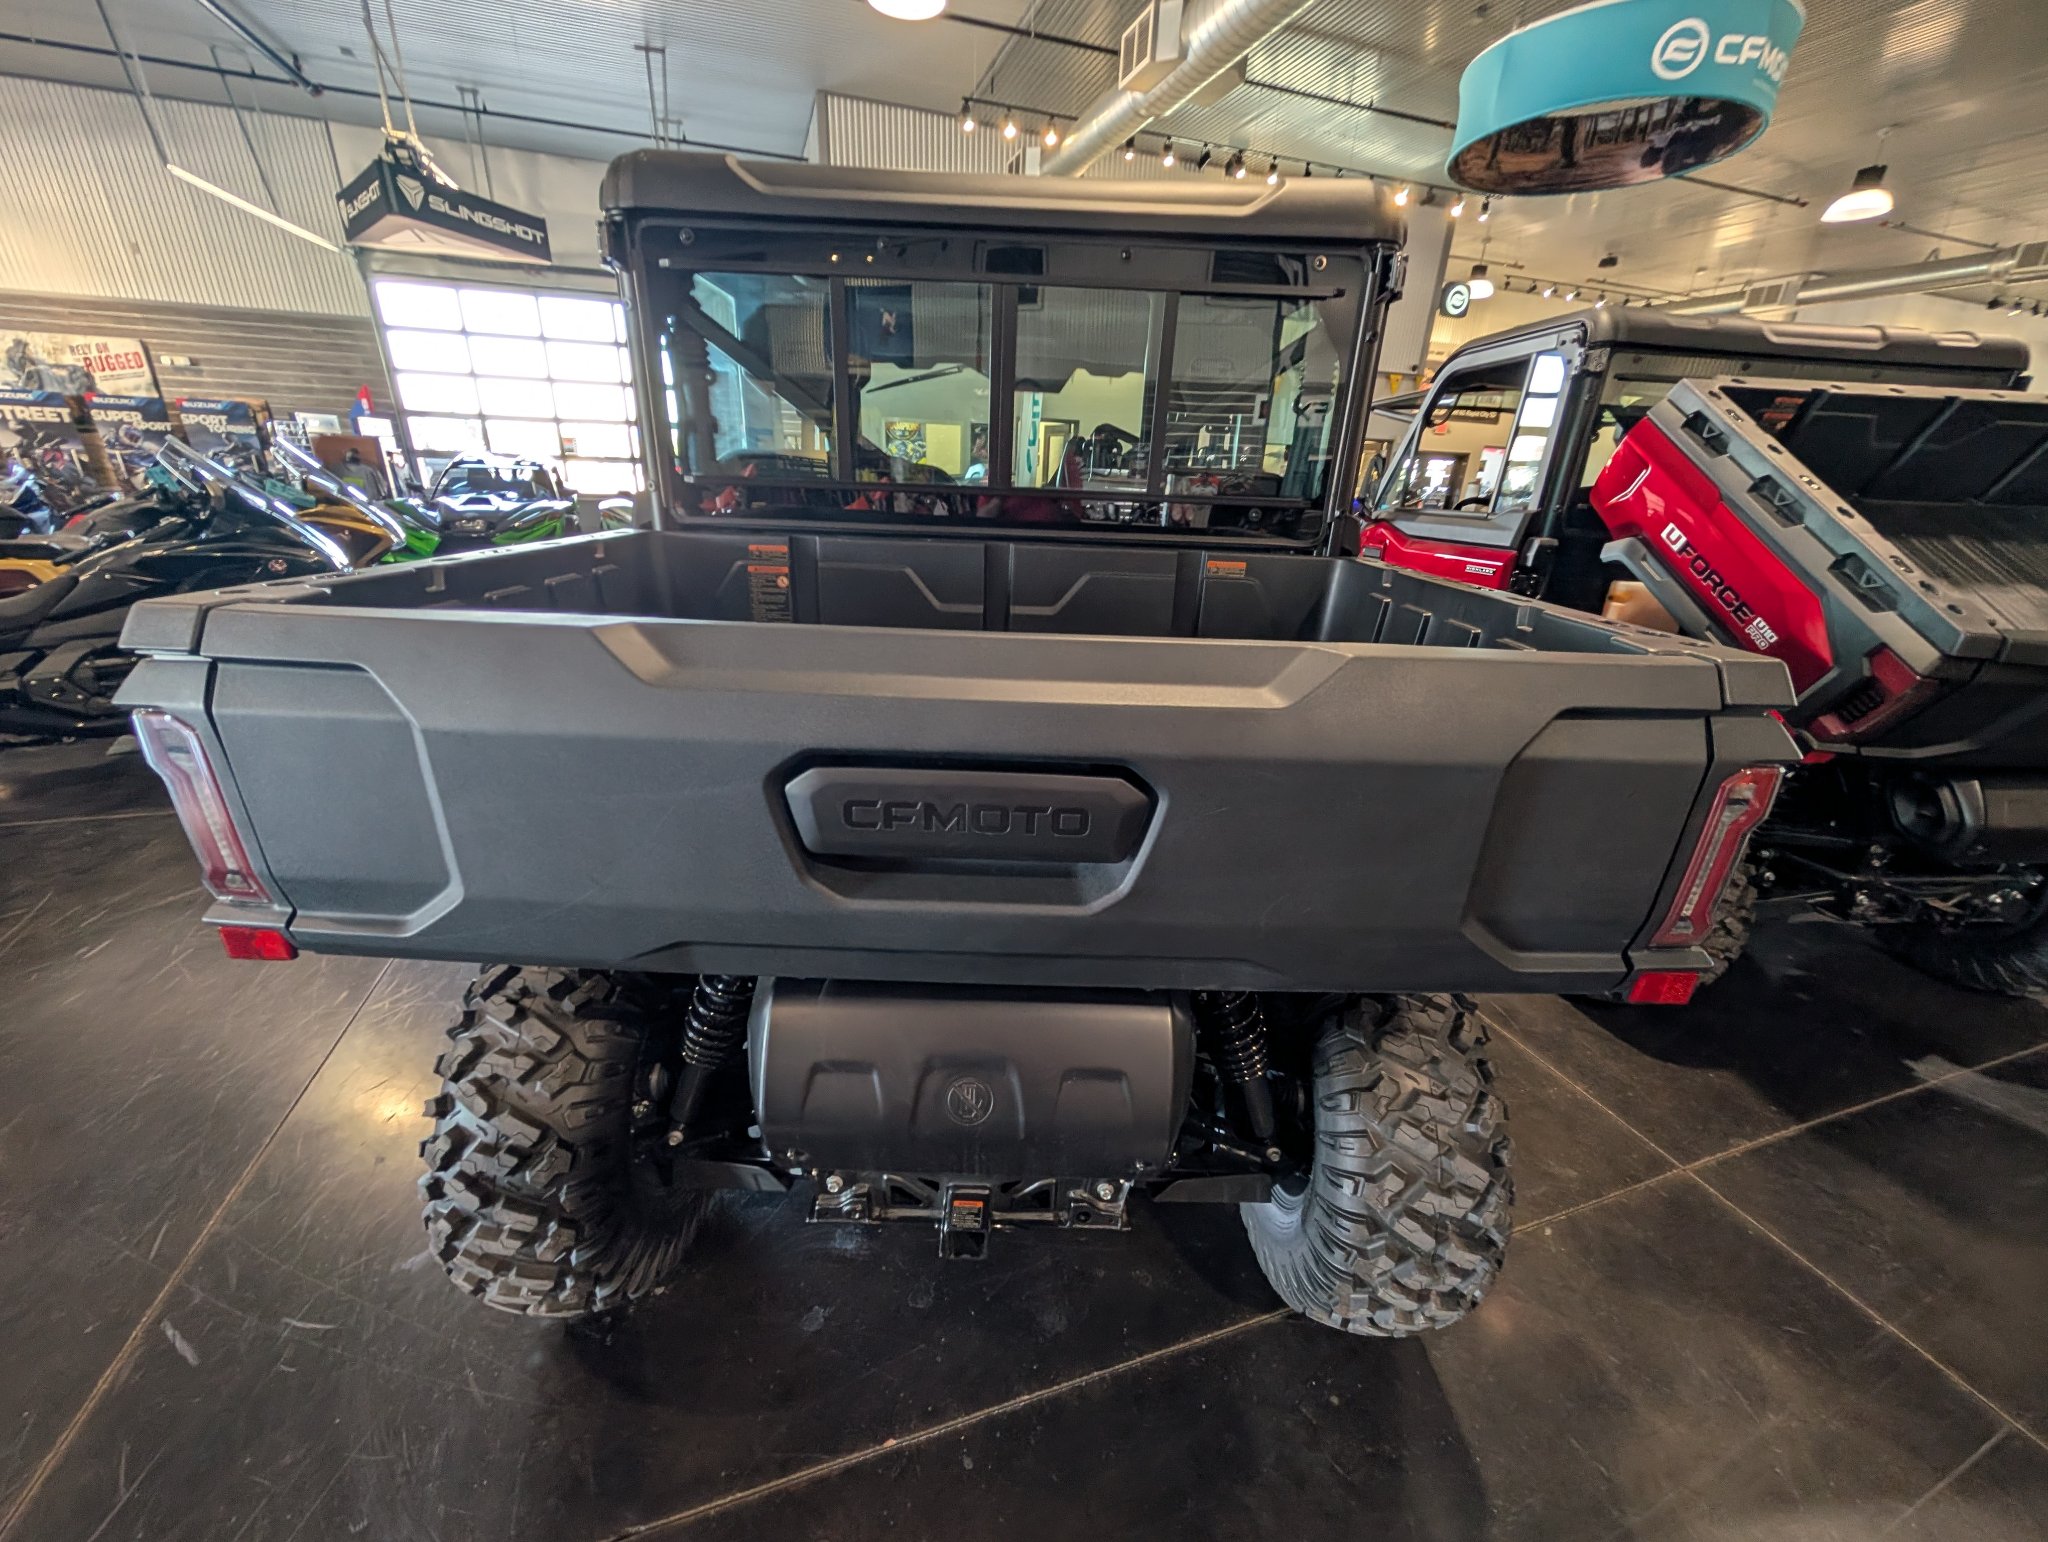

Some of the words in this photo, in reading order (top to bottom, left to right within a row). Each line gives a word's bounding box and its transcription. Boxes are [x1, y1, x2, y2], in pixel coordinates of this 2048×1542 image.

[428, 194, 545, 245] SLINGSHOT
[69, 343, 92, 356] RELY
[95, 341, 110, 354] ON
[82, 351, 144, 374] RUGGED
[90, 408, 142, 423] SUPER
[180, 413, 228, 426] SPORT
[132, 421, 172, 432] SPORT
[207, 424, 256, 434] TOURING
[1744, 624, 1769, 650] PRO
[843, 799, 1091, 837] CFMOTO
